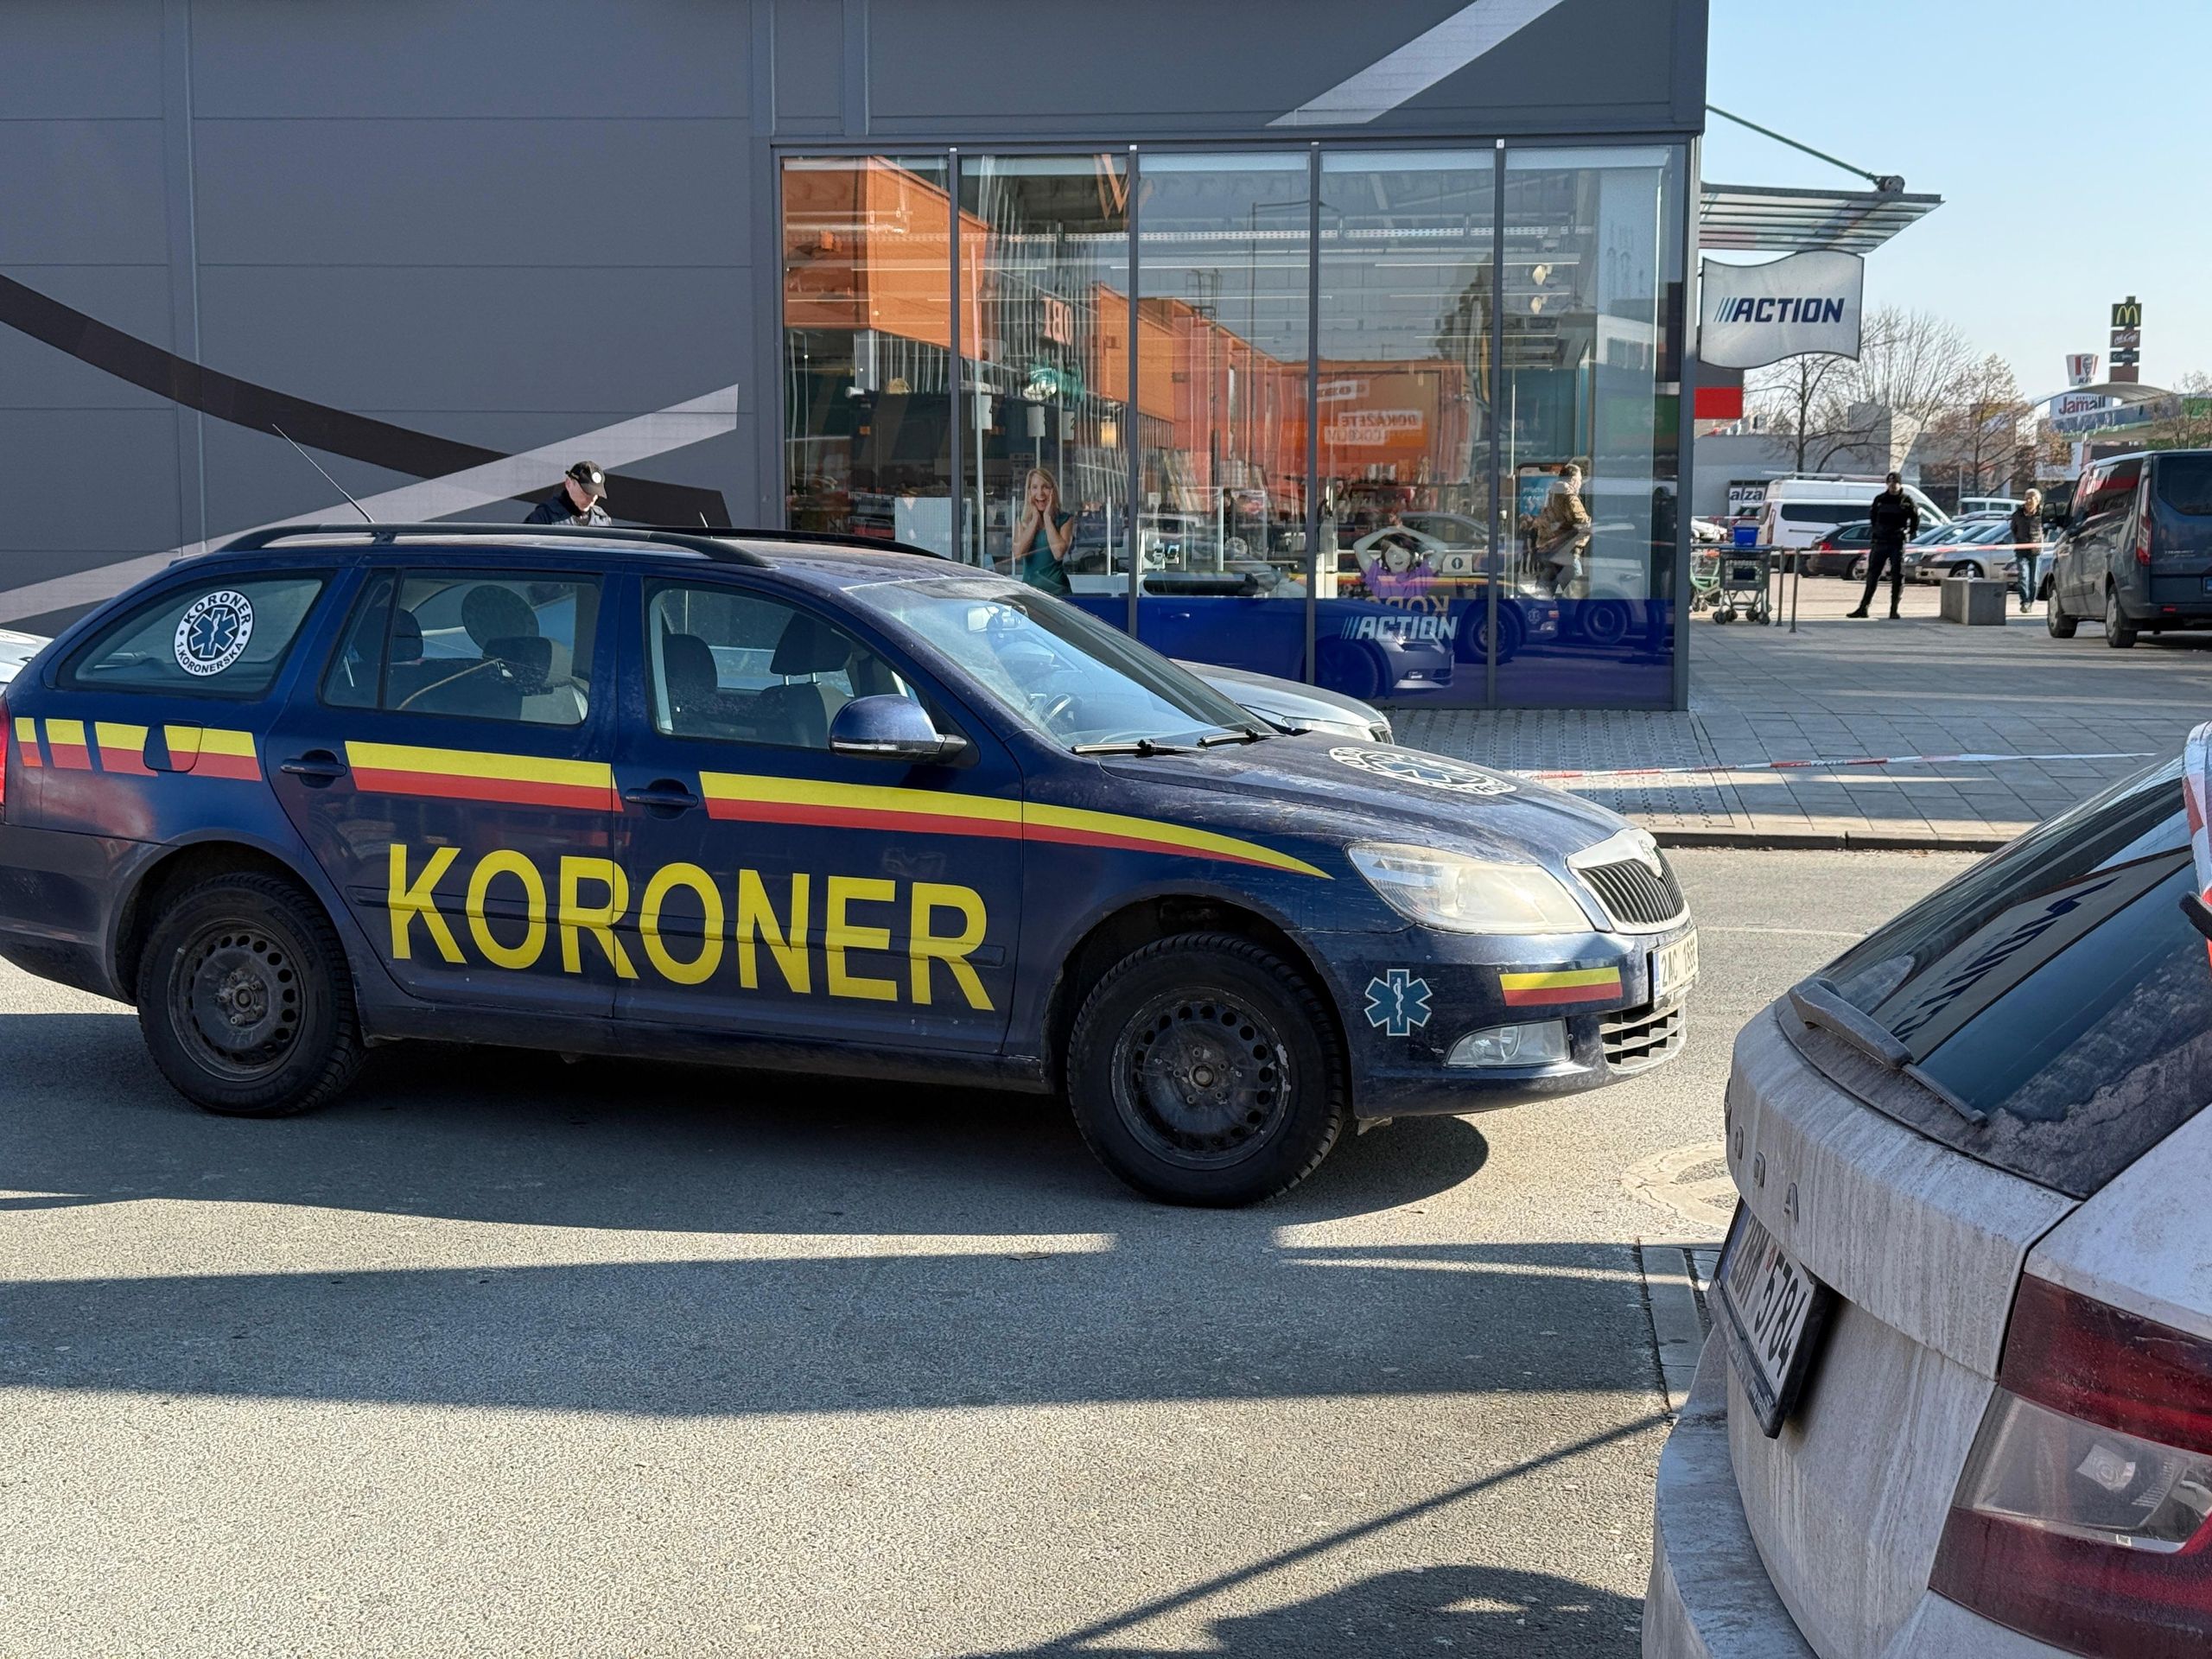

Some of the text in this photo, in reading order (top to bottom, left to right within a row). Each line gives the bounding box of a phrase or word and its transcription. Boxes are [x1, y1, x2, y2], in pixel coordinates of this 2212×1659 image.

[1731, 297, 1845, 323] ACTION
[183, 593, 251, 626] KORONER
[1356, 616, 1458, 639] ACTION
[388, 843, 995, 1011] KORONER
[1754, 1249, 1808, 1379] 5784
